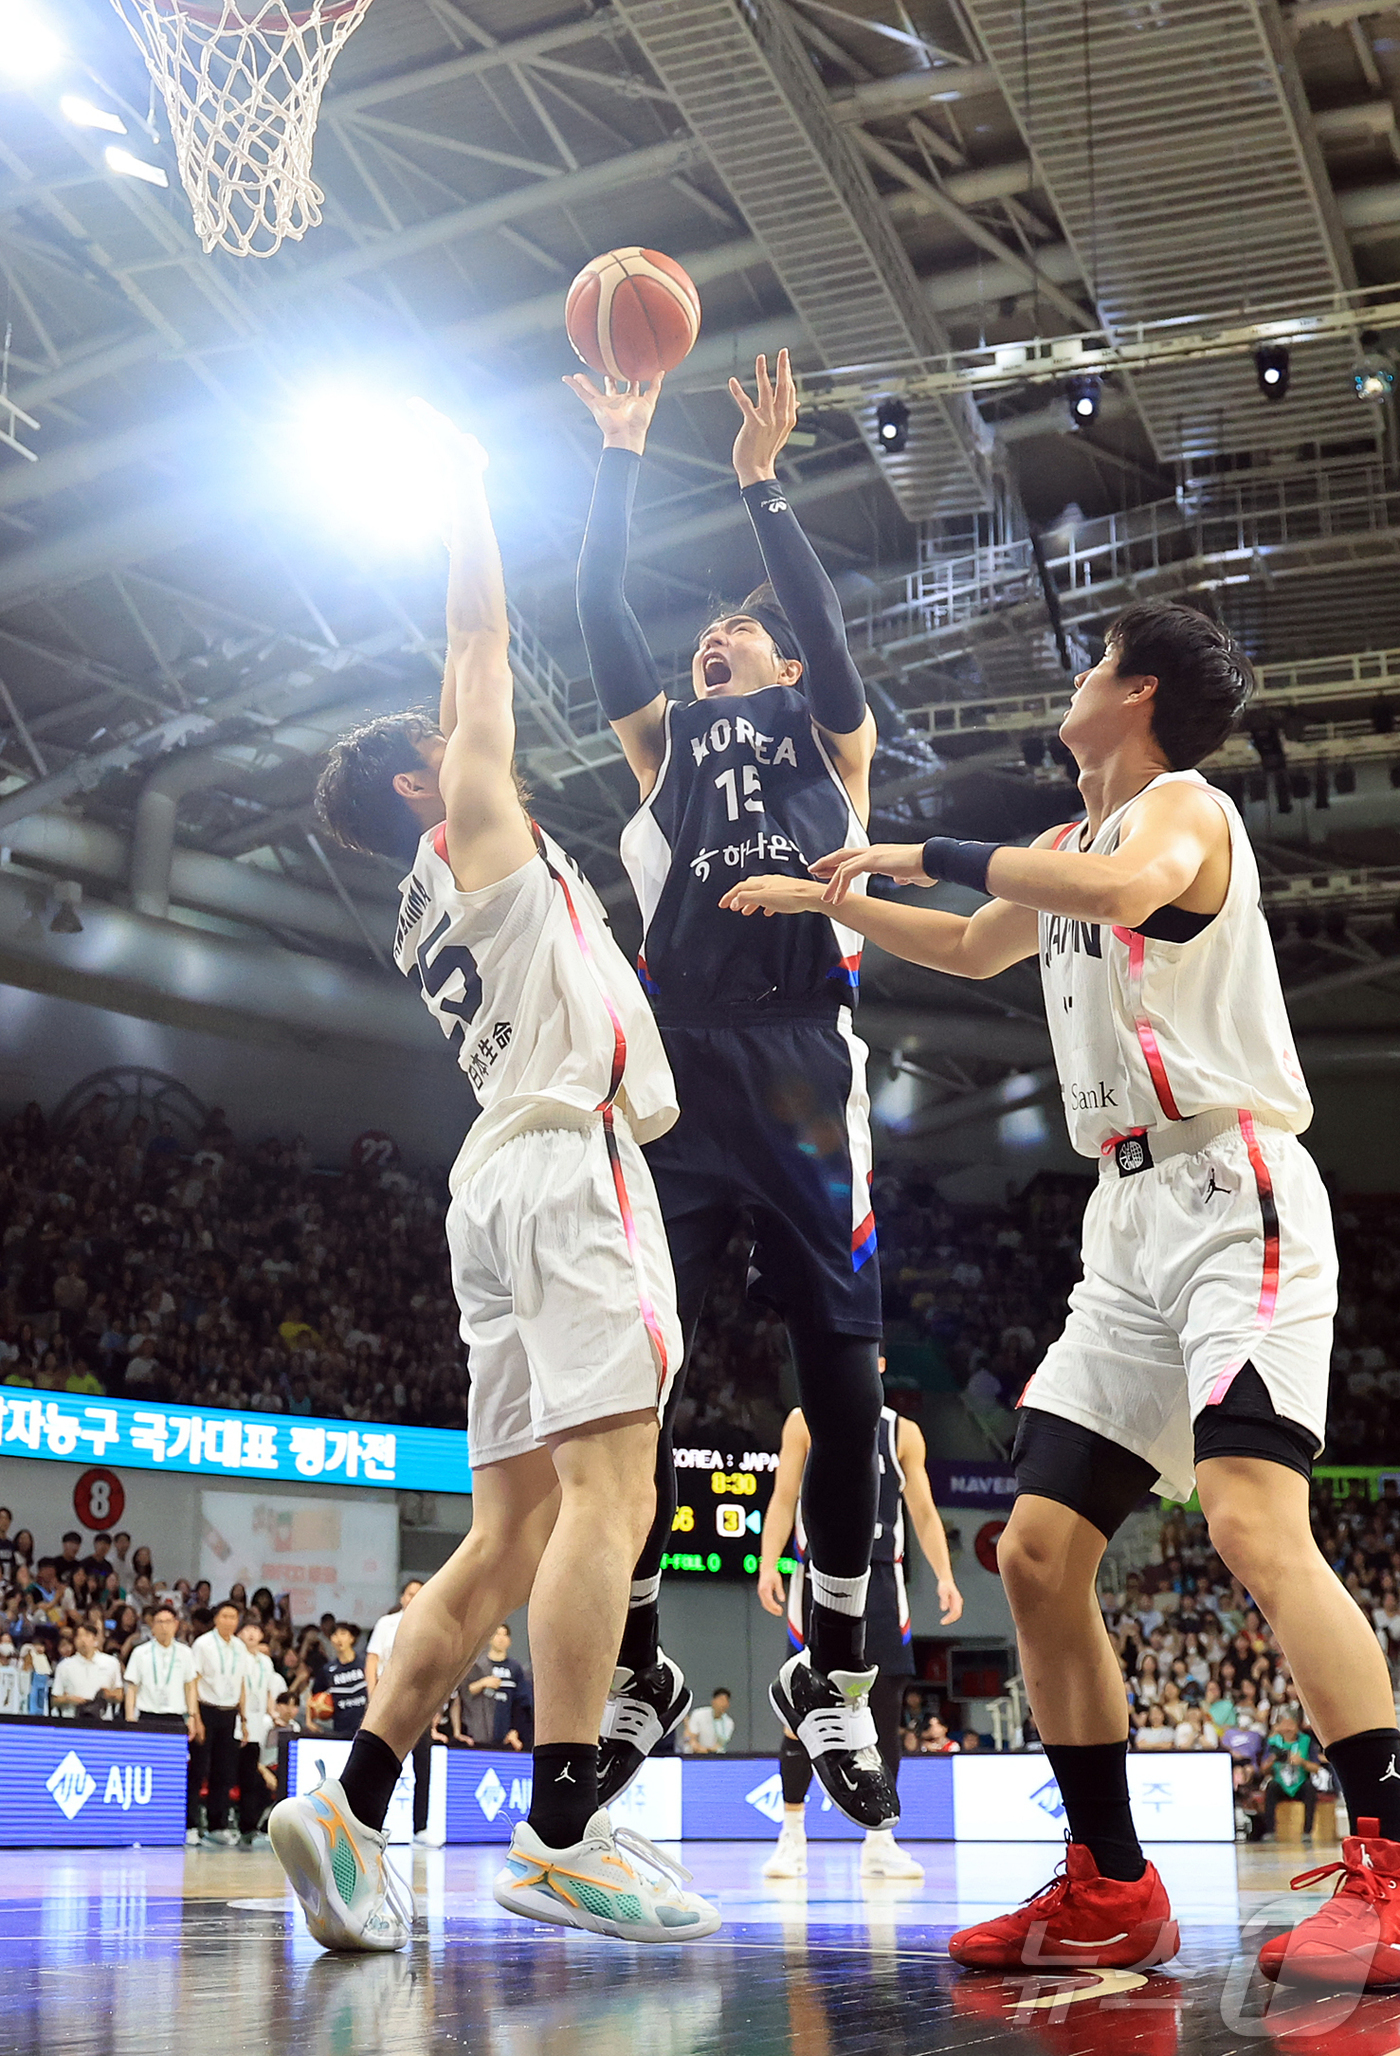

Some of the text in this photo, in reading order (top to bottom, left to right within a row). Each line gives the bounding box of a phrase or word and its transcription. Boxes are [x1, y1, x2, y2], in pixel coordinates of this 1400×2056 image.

[690, 716, 798, 768] KOREA
[714, 764, 765, 822] 15
[723, 832, 808, 869] 하나은
[467, 1020, 513, 1091] 日本生命
[129, 1411, 279, 1466] 국가대표
[289, 1426, 397, 1481] 평가전
[89, 1479, 111, 1520] 8
[722, 1509, 740, 1532] 3
[103, 1764, 153, 1811] AJU
